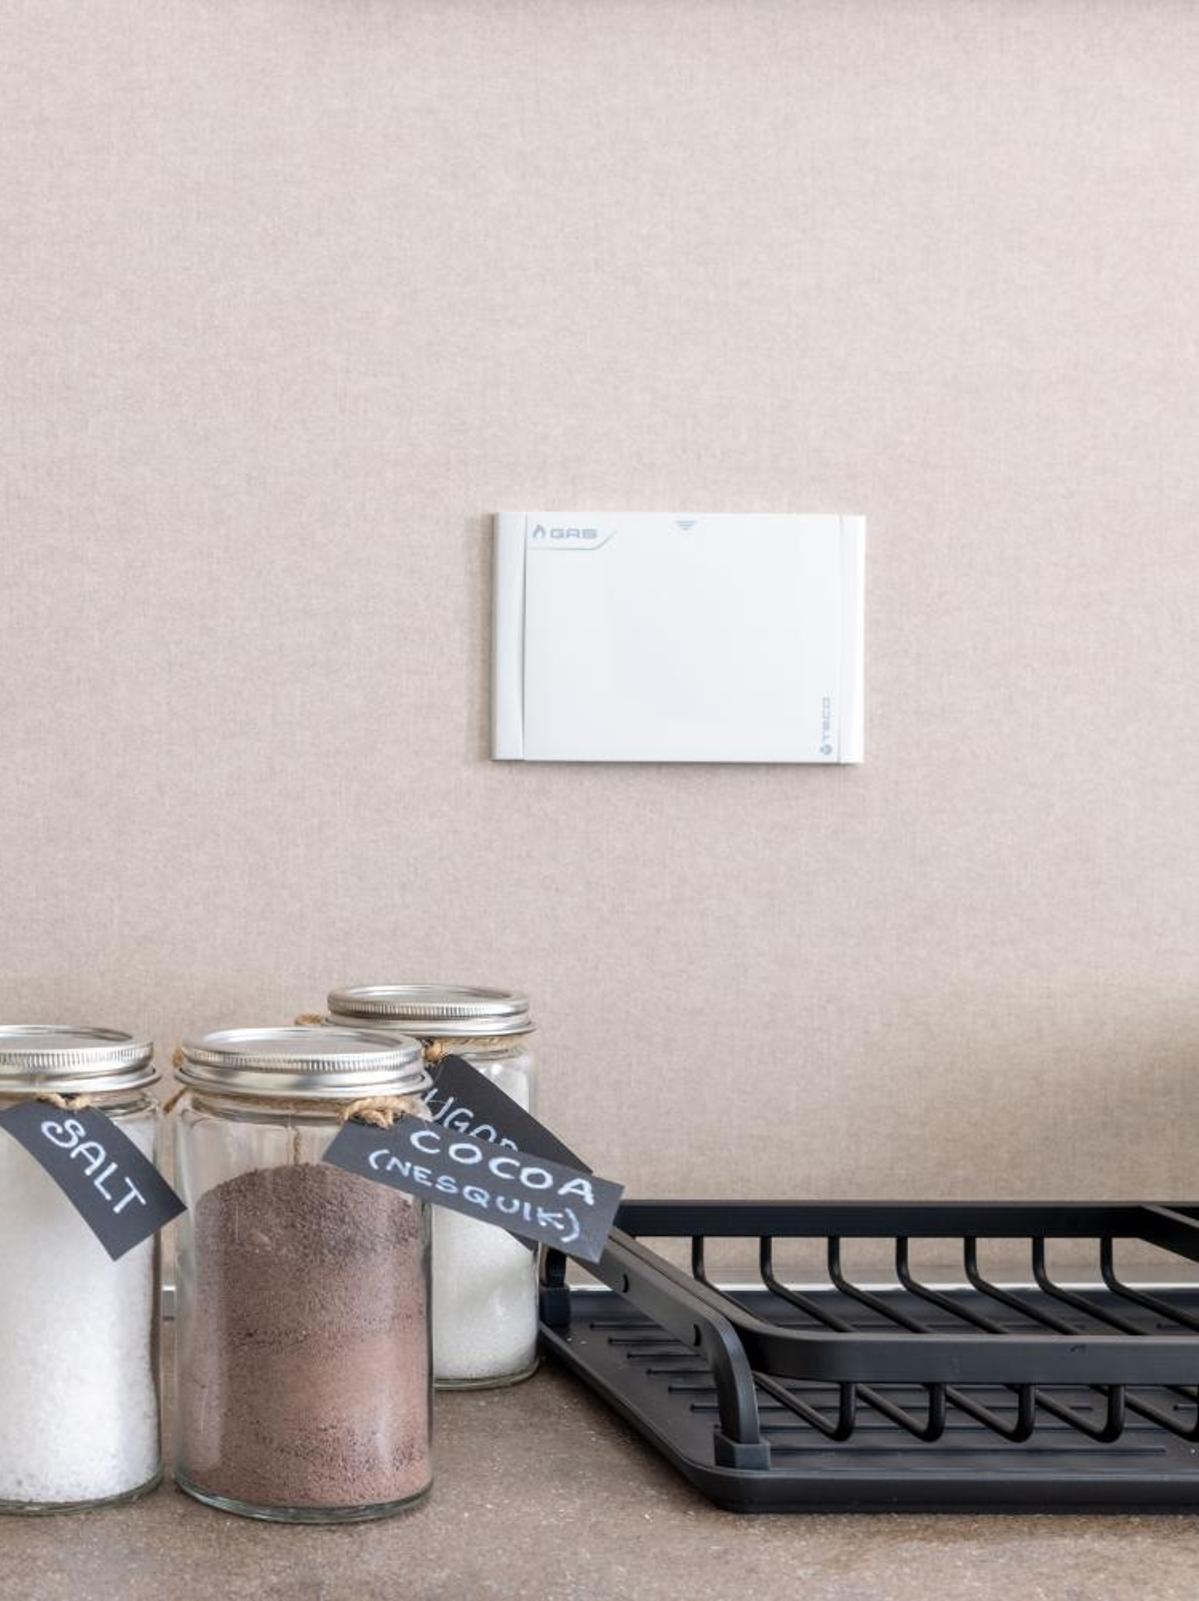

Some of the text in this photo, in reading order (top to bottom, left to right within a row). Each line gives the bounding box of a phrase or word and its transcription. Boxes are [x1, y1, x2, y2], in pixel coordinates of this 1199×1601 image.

[549, 528, 598, 539] GAS
[40, 1118, 147, 1214] SALT
[368, 1149, 581, 1243] (NESQUIK)
[410, 1130, 595, 1206] COCOA
